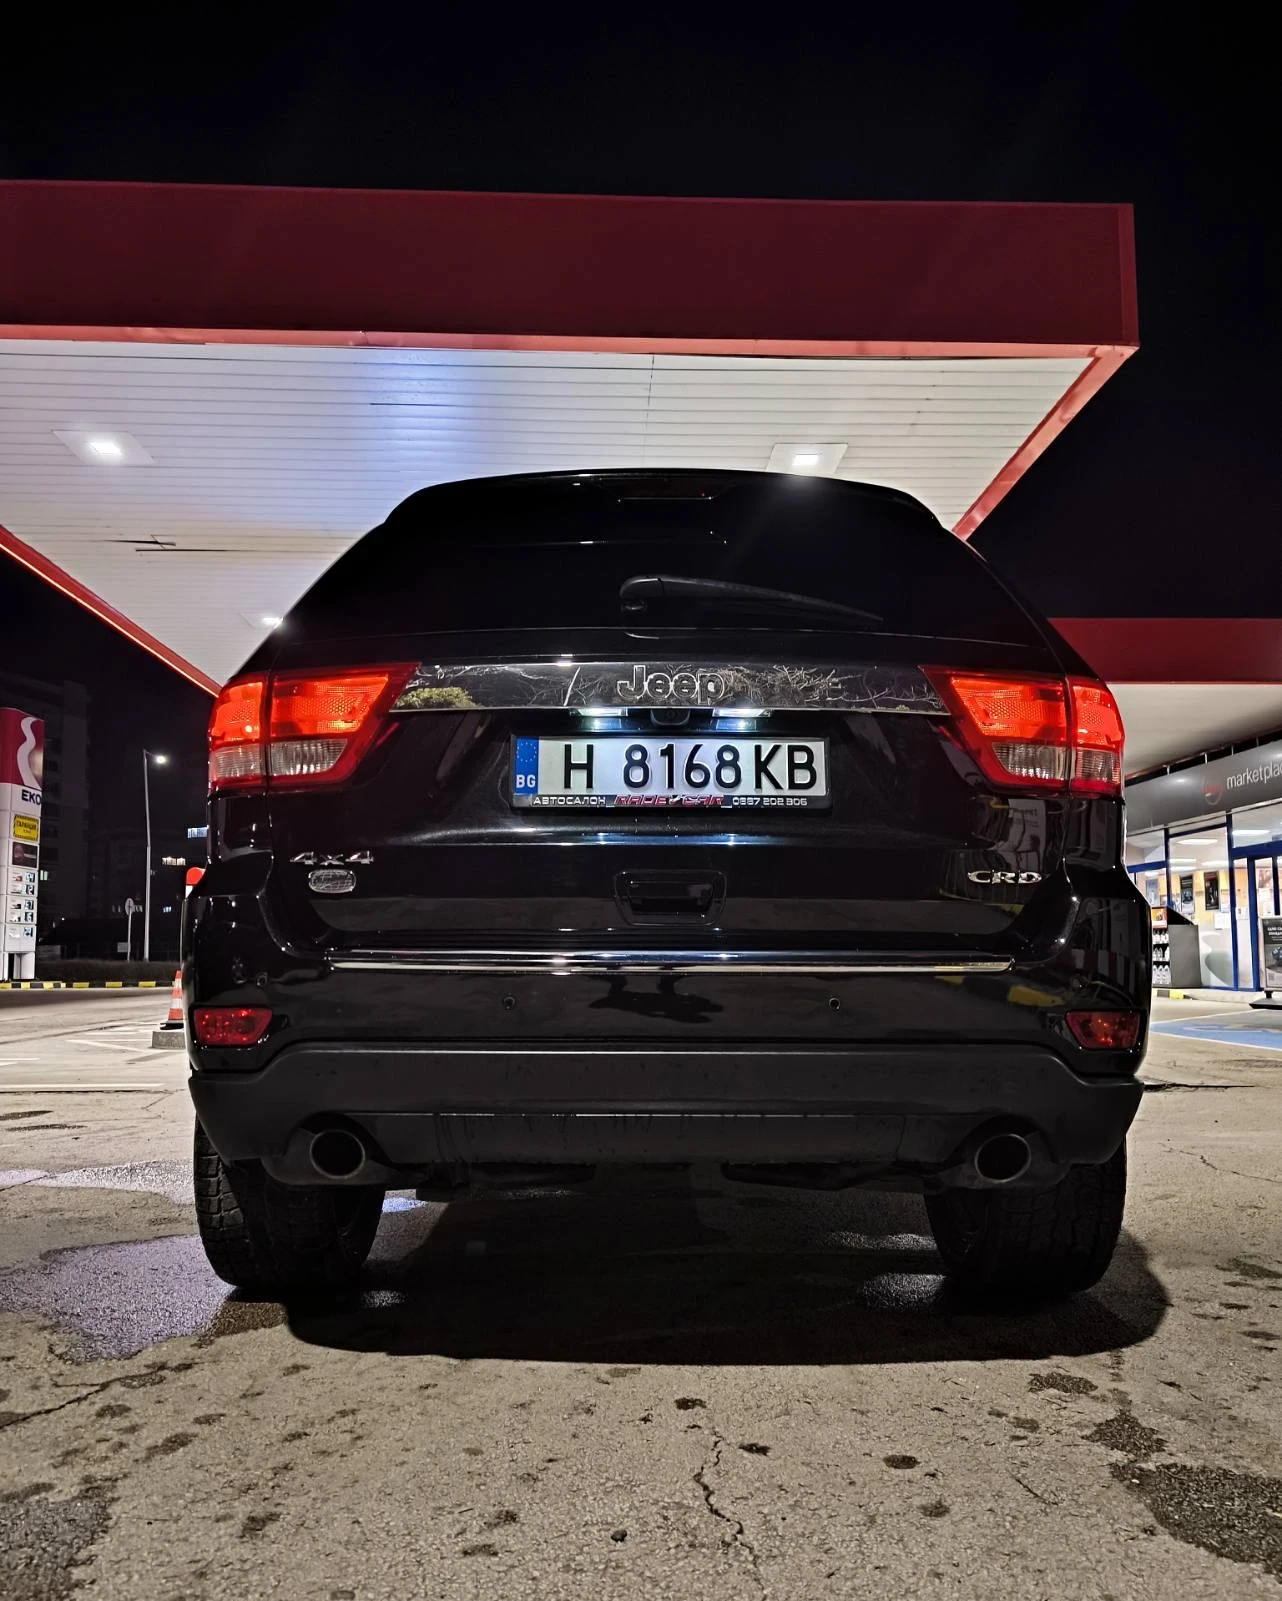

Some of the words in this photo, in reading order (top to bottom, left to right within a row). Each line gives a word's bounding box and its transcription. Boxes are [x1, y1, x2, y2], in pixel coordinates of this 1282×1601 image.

[617, 665, 724, 705] Jeep
[563, 744, 594, 789] H
[623, 744, 742, 789] 8168
[754, 744, 817, 790] KB
[515, 775, 536, 789] BG
[22, 789, 42, 805] EKO
[533, 796, 606, 805] АВТОСАЛОН
[763, 798, 784, 806] 202
[290, 850, 374, 866] 4x4
[967, 870, 1042, 884] CRD
